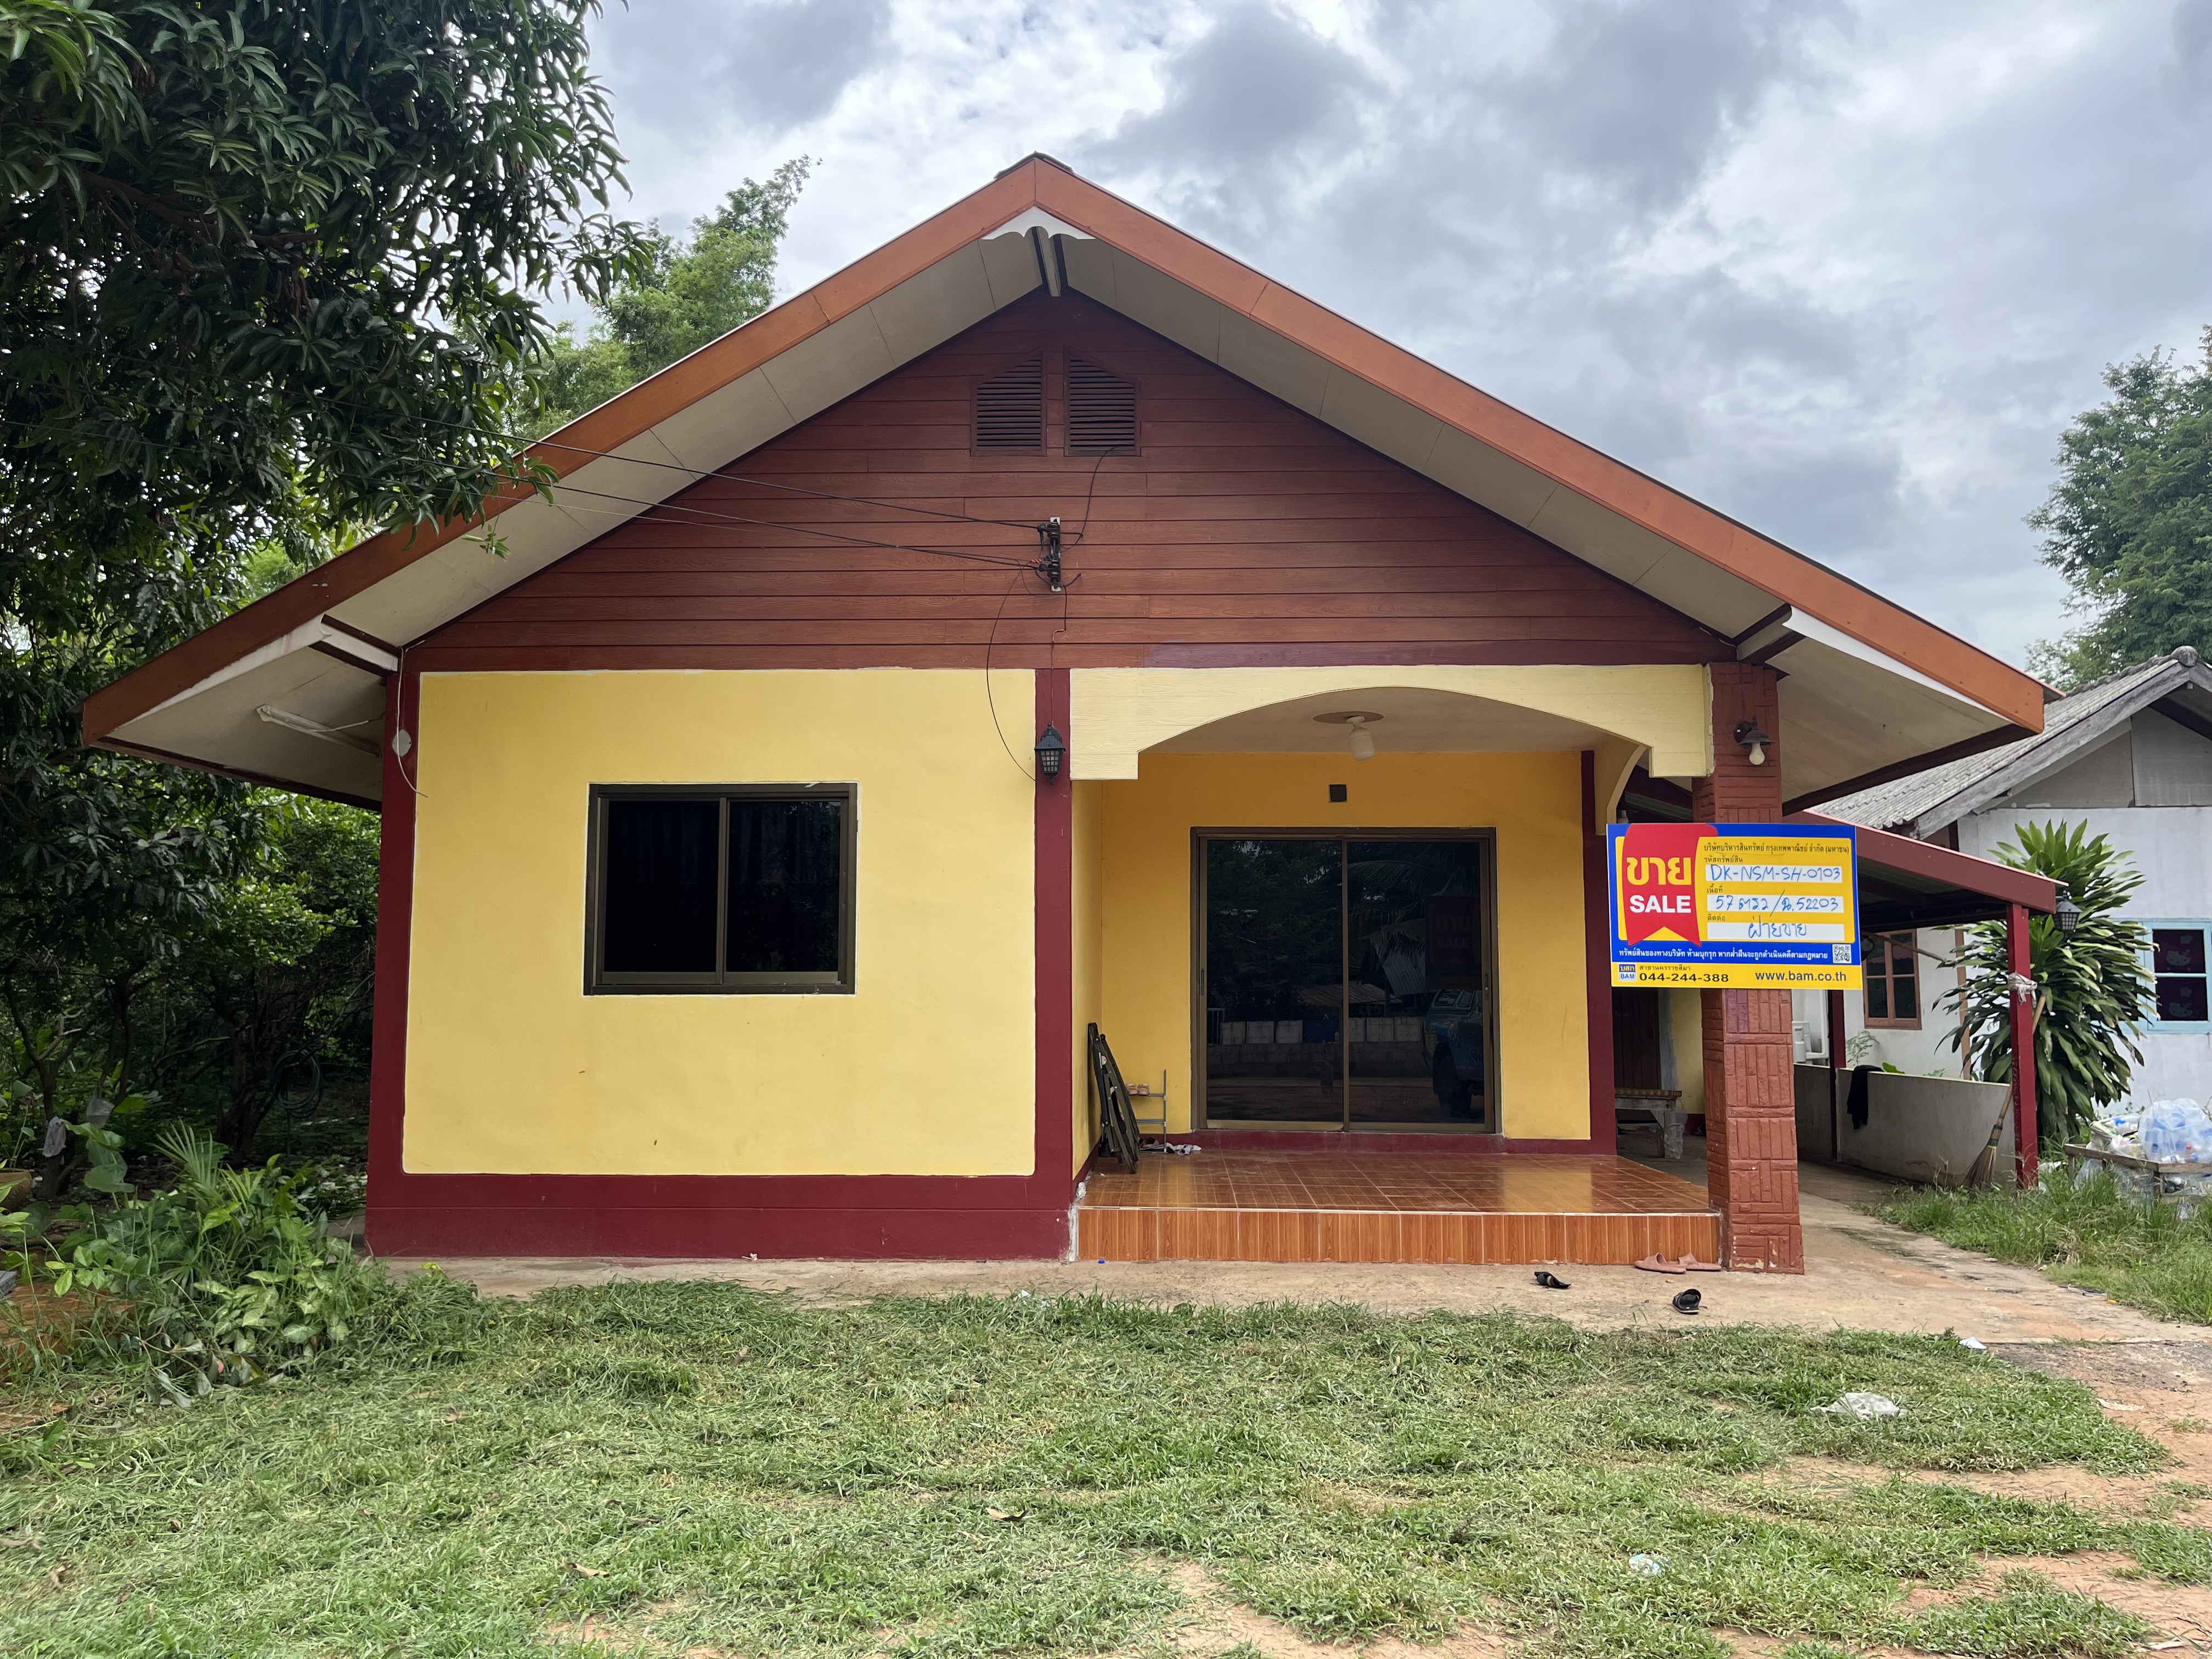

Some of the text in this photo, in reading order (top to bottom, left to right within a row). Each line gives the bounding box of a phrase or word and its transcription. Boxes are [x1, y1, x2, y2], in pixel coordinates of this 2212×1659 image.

[1703, 842, 1849, 854] บริษัทบริหารสินทรัพย์ กรุงเทพพาณิชย์ จำกัด (มหาชน)
[1704, 855, 1743, 863] รหัสทรัพย์สิน
[1626, 857, 1692, 885] ขาย
[1711, 864, 1841, 882] DK-NSM-SH-0103
[1707, 883, 1723, 894] เนื้อที่
[1629, 895, 1691, 913] SALE
[1716, 895, 1734, 911] 57
[1707, 913, 1726, 922] ติดต่อ
[1748, 915, 1807, 939] ฝ่ายขาย
[1436, 937, 1471, 949] SALE
[1619, 947, 1685, 957] ทรัพย์สินของทางบริษัท
[1687, 949, 1717, 960] ห้ามบุกรุก
[1639, 973, 1729, 982] 044-244-388
[1755, 970, 1847, 981] www.bam.co.th
